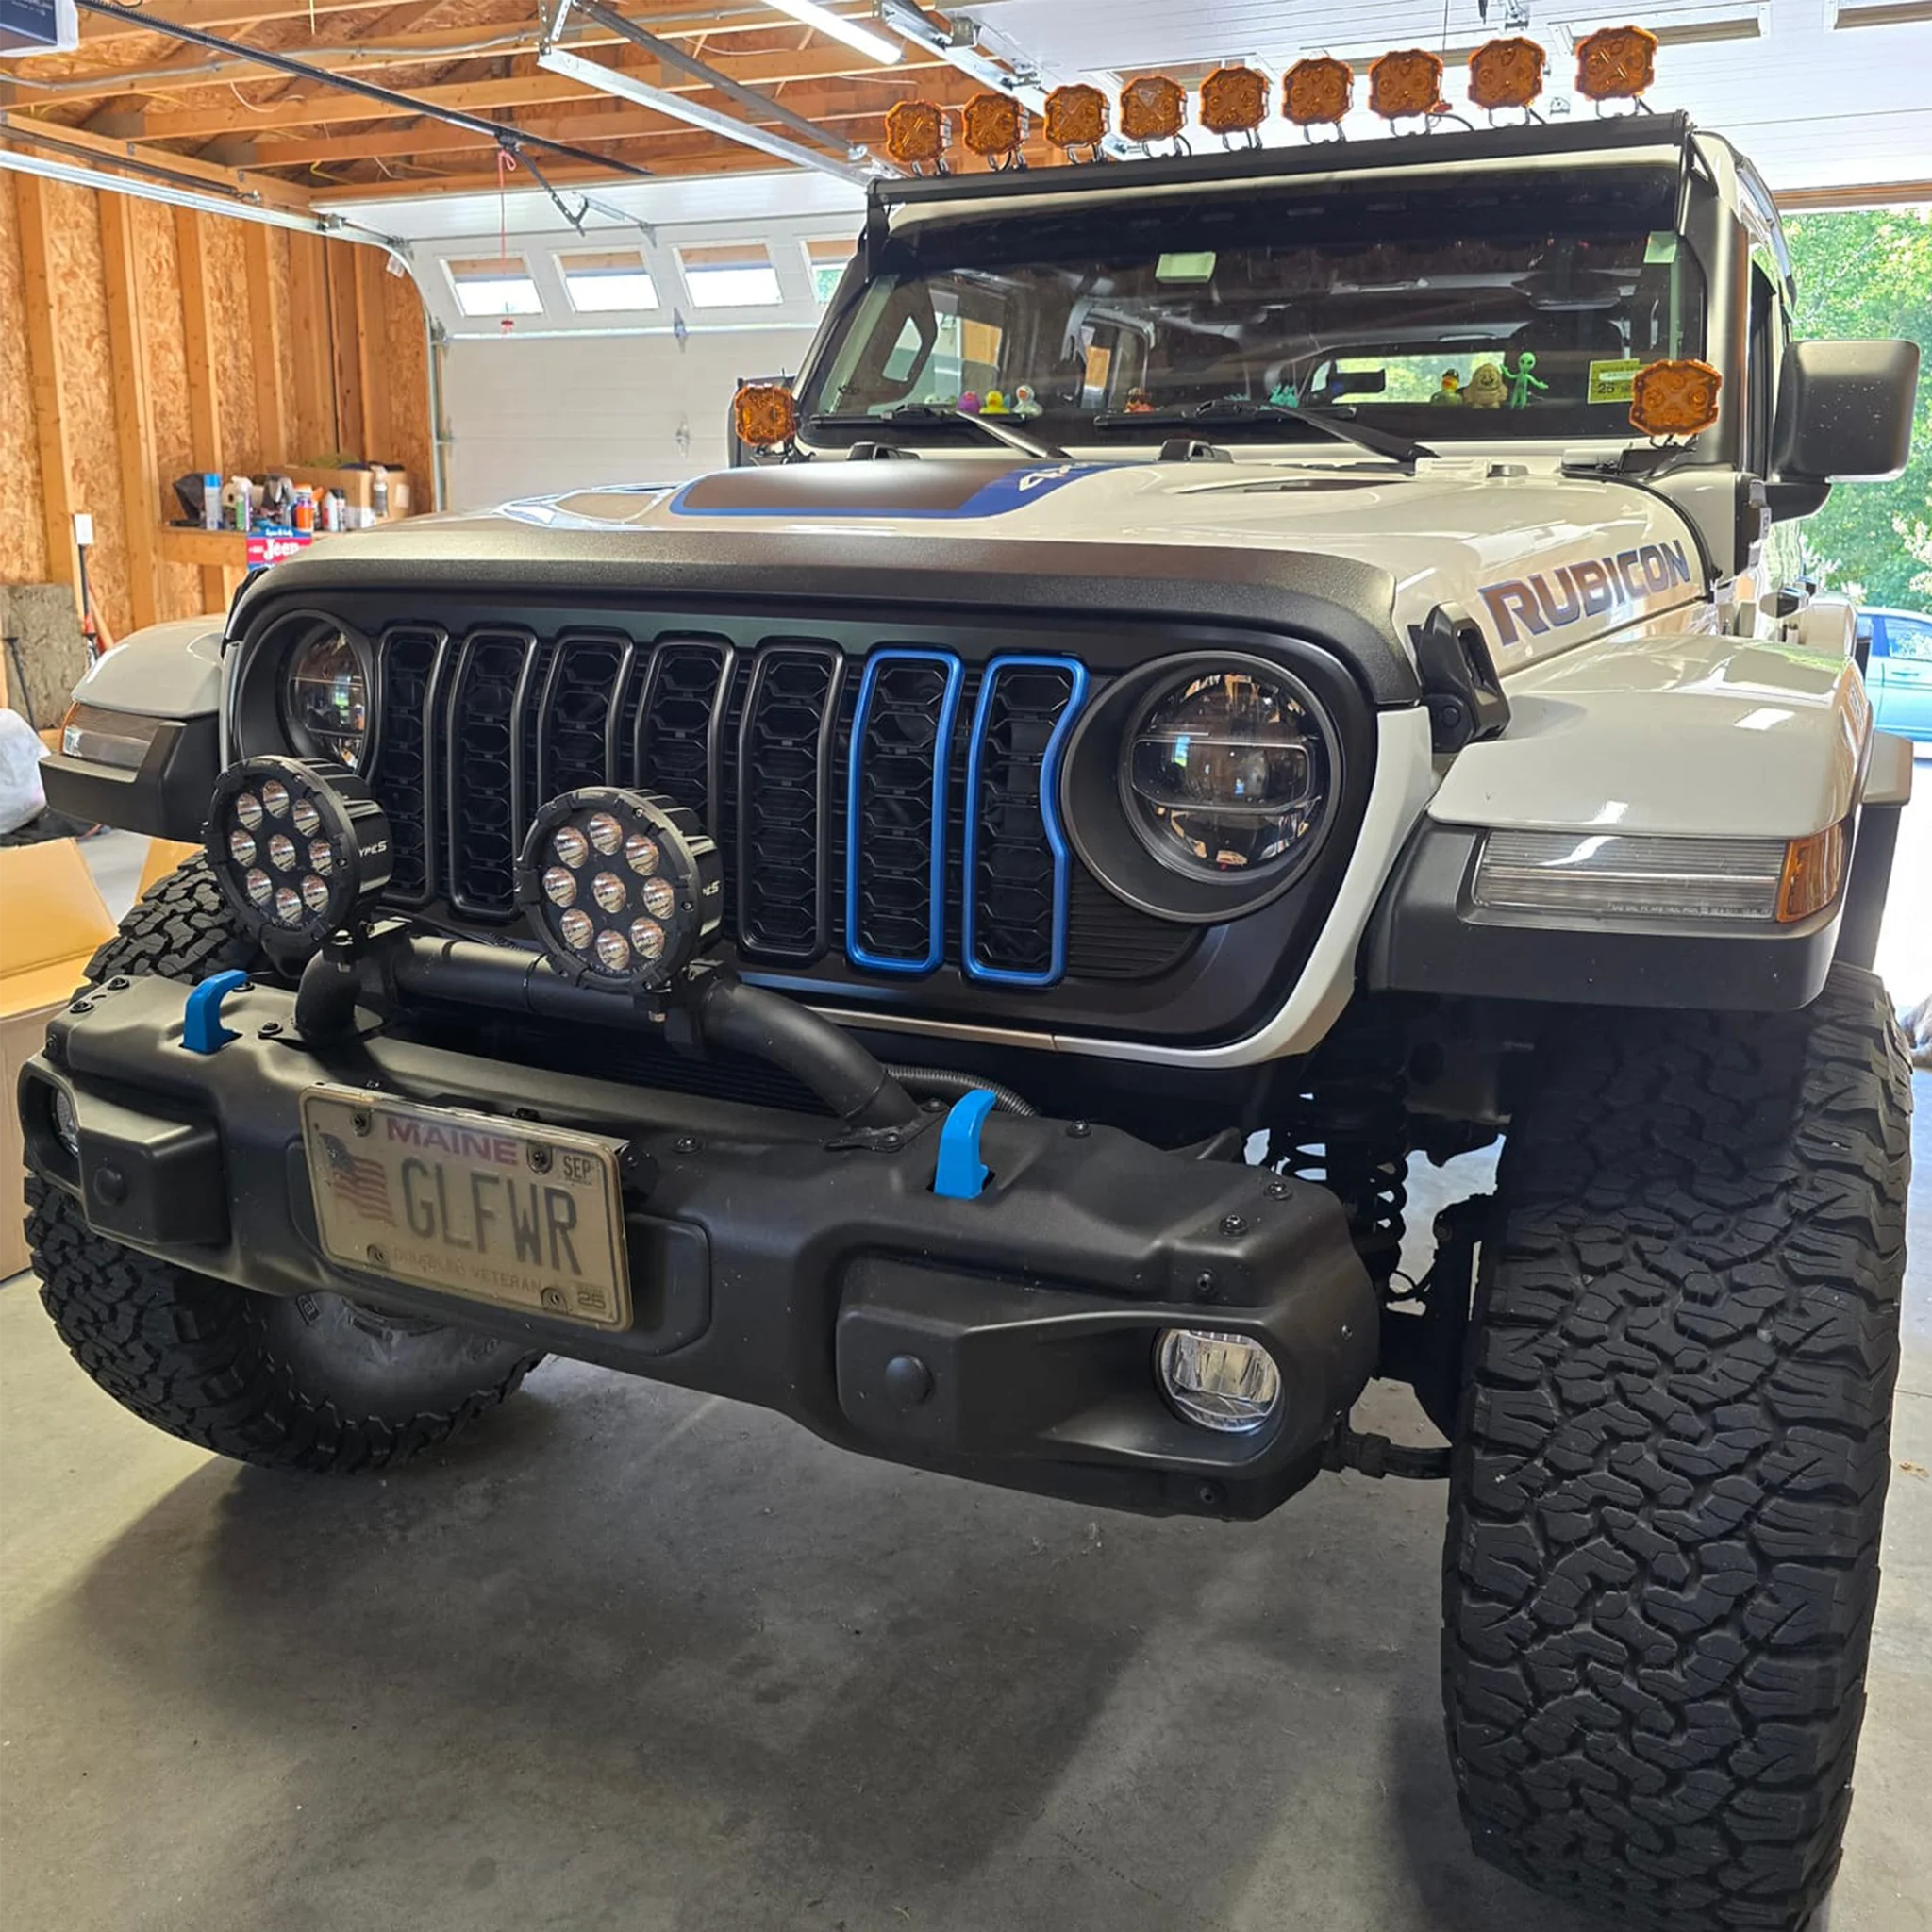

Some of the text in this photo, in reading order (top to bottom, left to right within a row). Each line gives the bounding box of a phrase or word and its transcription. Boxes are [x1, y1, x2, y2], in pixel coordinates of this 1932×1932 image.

[263, 538, 300, 559] Jeep
[1478, 540, 1690, 647] RUBICON
[387, 1117, 518, 1166] MAINE
[563, 1155, 591, 1179] SEP
[401, 1157, 582, 1275] GLFWR
[577, 1291, 606, 1310] 25
